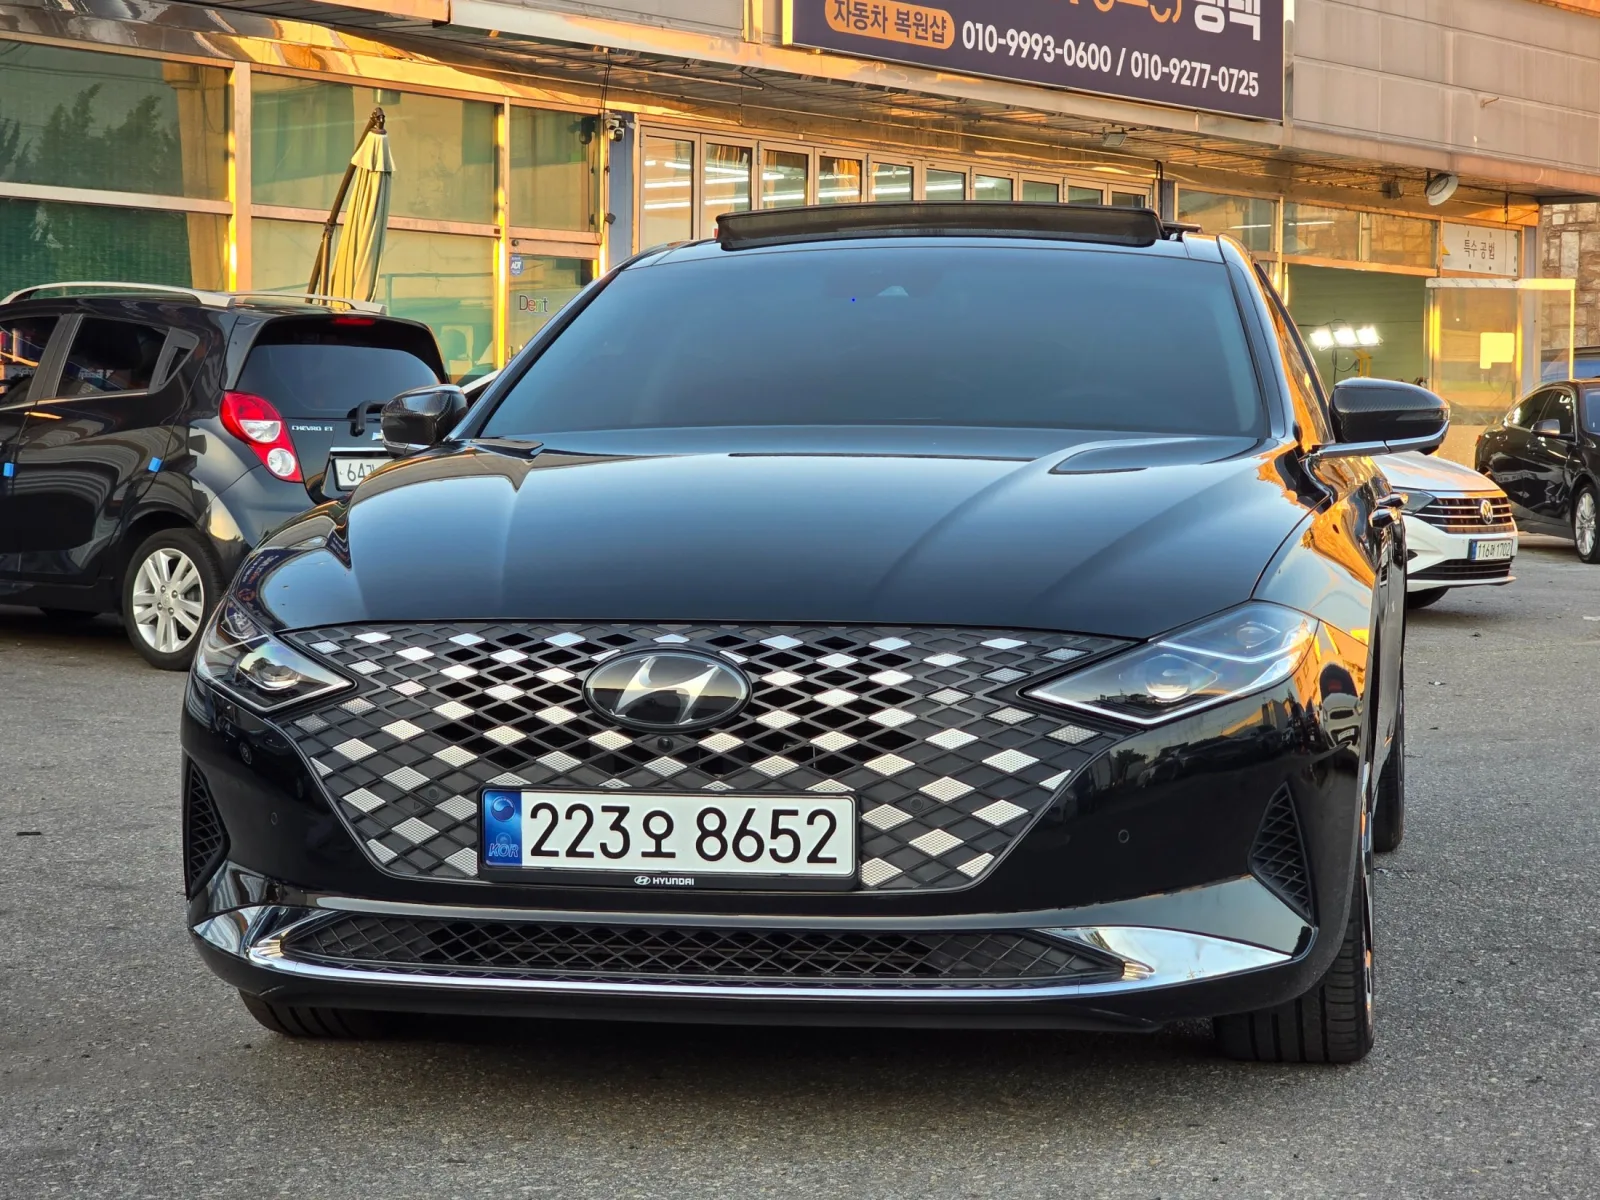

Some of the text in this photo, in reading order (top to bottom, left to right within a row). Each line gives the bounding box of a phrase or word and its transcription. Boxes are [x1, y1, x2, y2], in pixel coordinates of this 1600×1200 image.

[833, 0, 947, 44] 자동차 복원샵
[962, 20, 1112, 74] 010-9993-0600
[1130, 50, 1260, 98] 010-9277-0725
[1464, 239, 1495, 260] 특수 공법
[519, 294, 548, 312] Dent
[530, 802, 838, 864] 223오 8652
[489, 842, 519, 857] KOR
[652, 877, 695, 886] HYUNDAI
